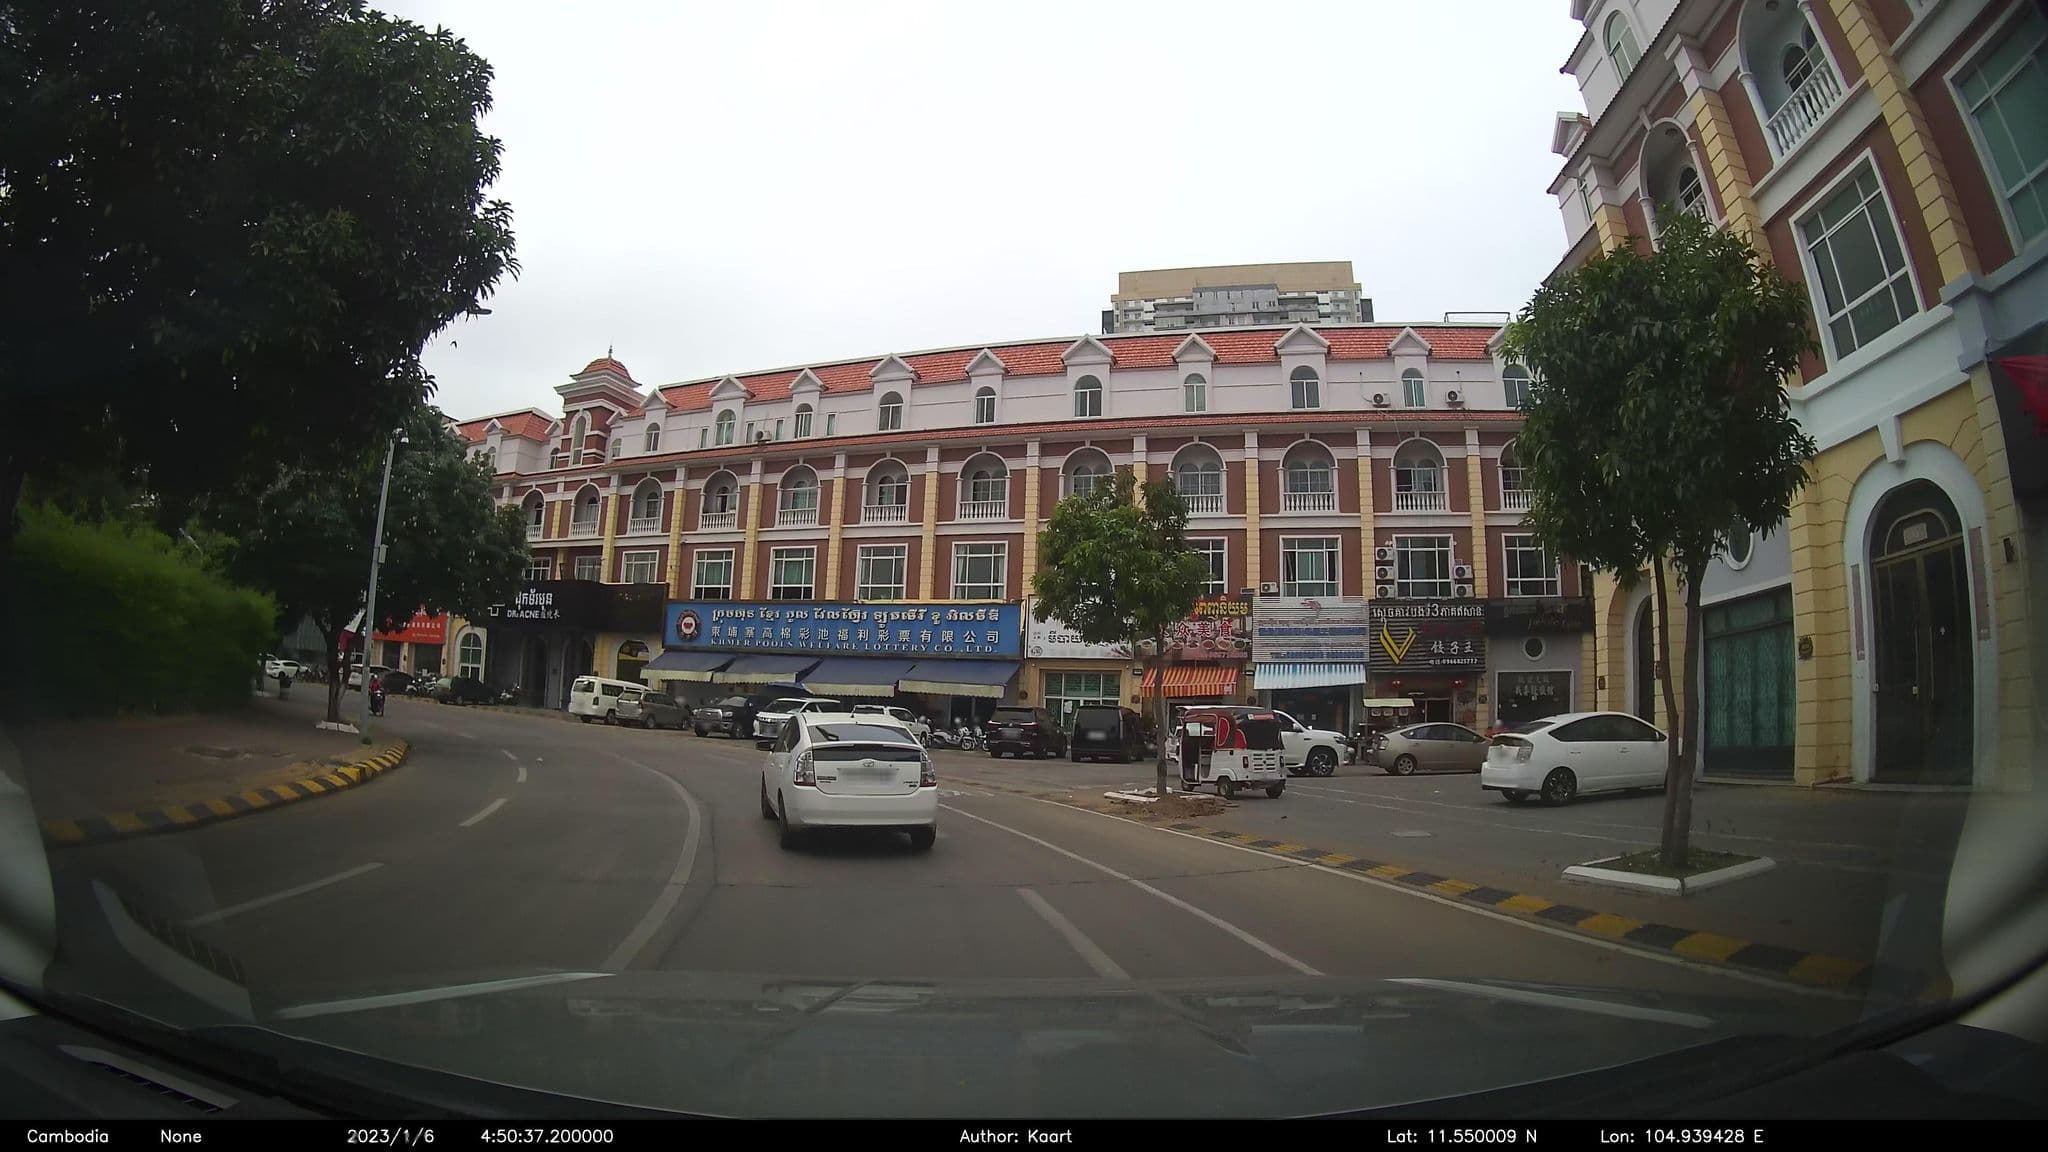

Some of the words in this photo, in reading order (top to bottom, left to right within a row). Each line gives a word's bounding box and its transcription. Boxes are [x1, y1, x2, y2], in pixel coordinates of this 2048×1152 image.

[520, 610, 540, 619] ACNE
[800, 641, 858, 650] WELFARE
[864, 643, 927, 652] LOTTERY
